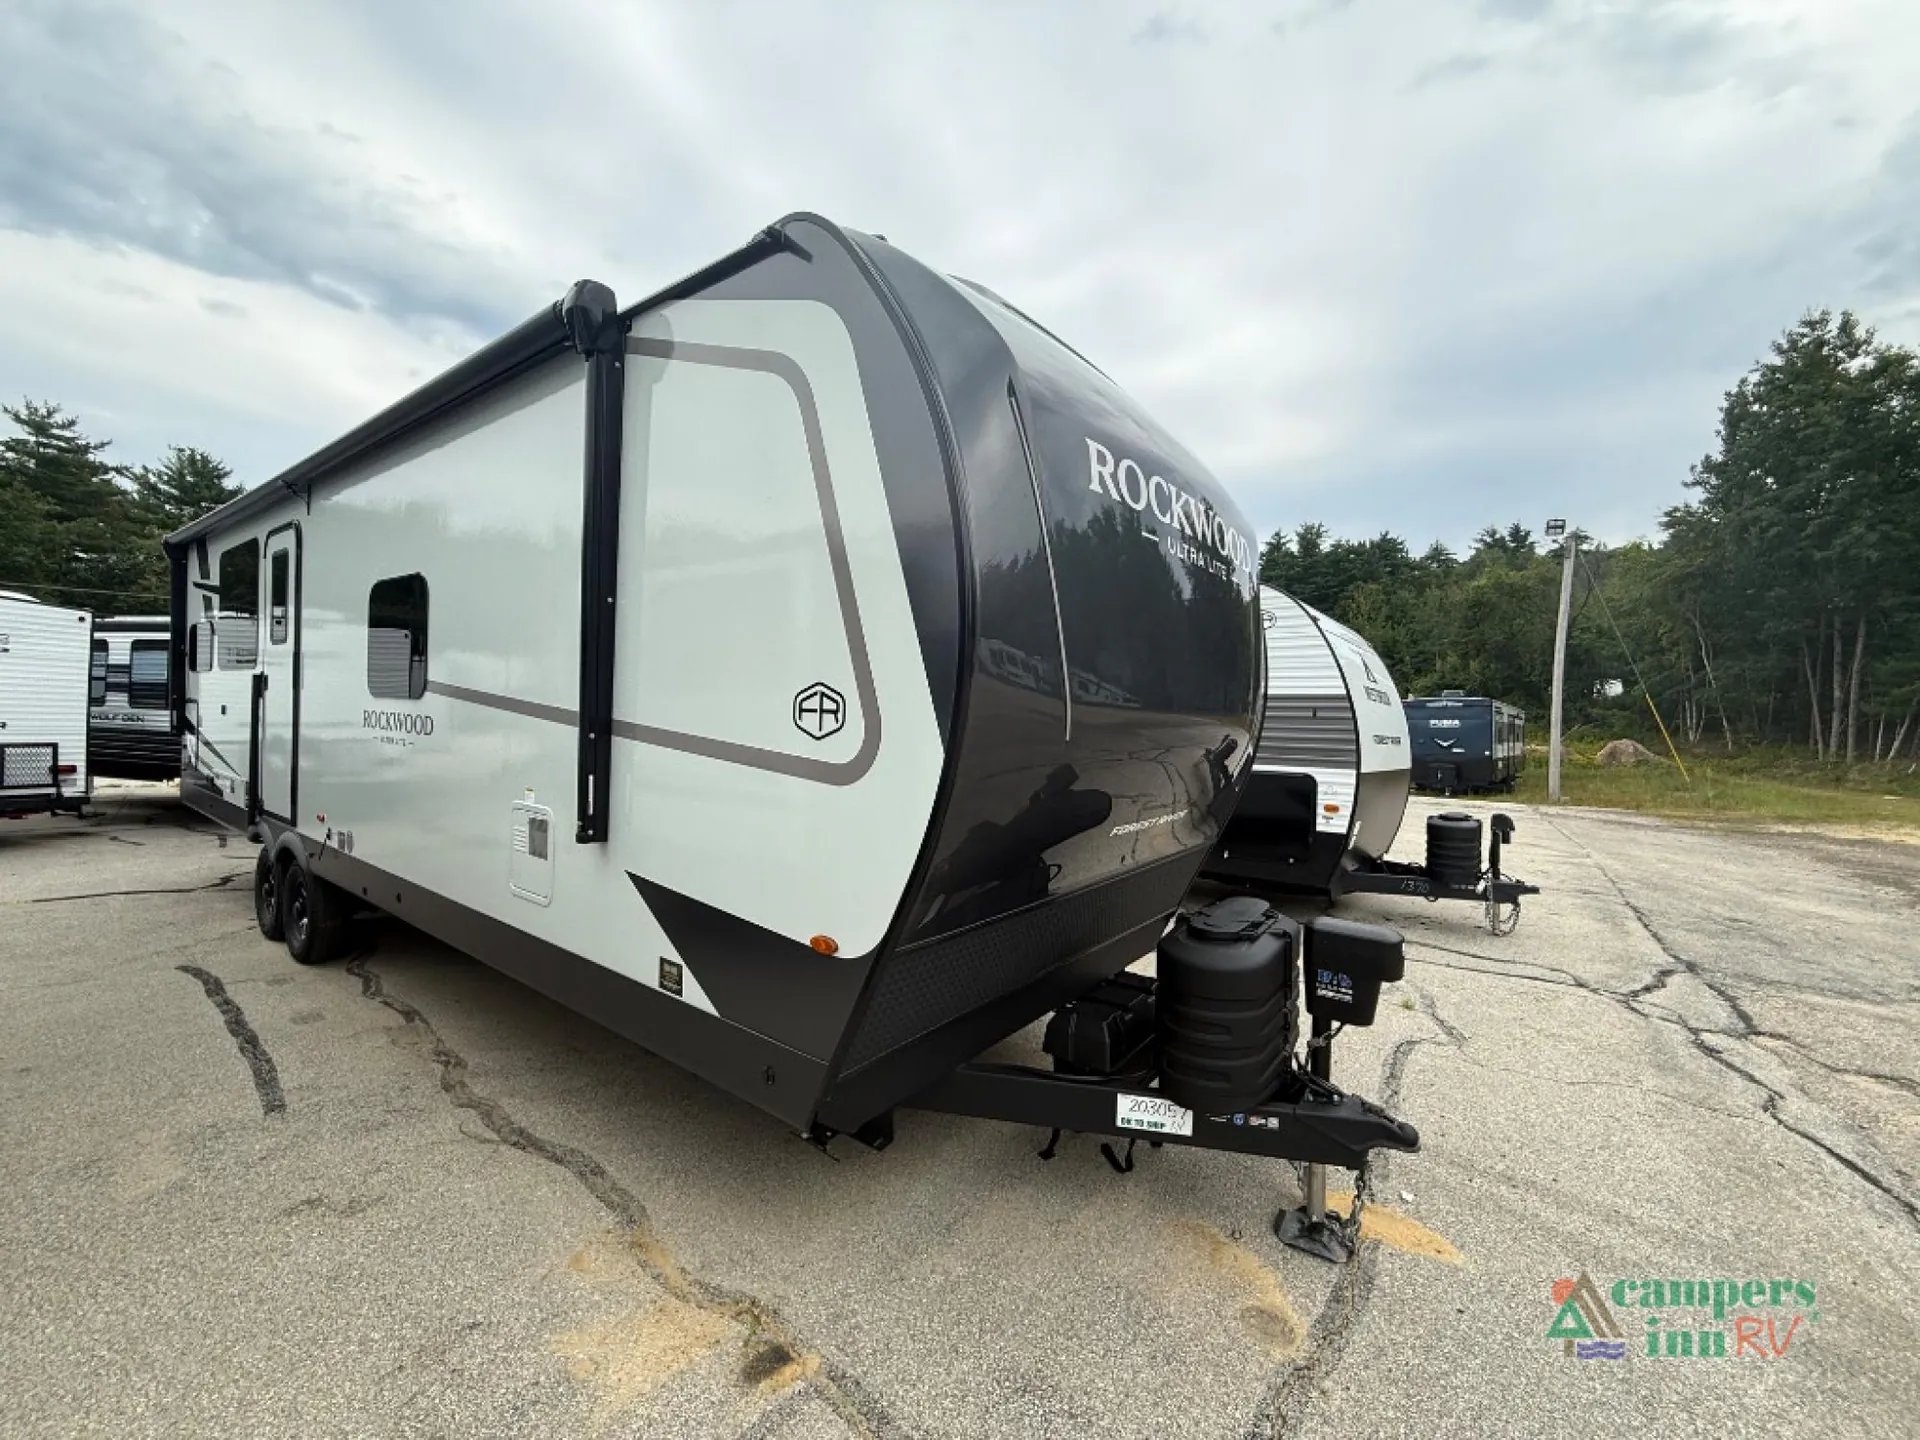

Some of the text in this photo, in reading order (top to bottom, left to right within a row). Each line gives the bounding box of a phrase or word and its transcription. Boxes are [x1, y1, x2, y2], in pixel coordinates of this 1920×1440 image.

[1084, 436, 1252, 572] ROCKWOOD
[1167, 535, 1228, 581] ULTRA LITE
[362, 709, 434, 736] ROCKWOOD
